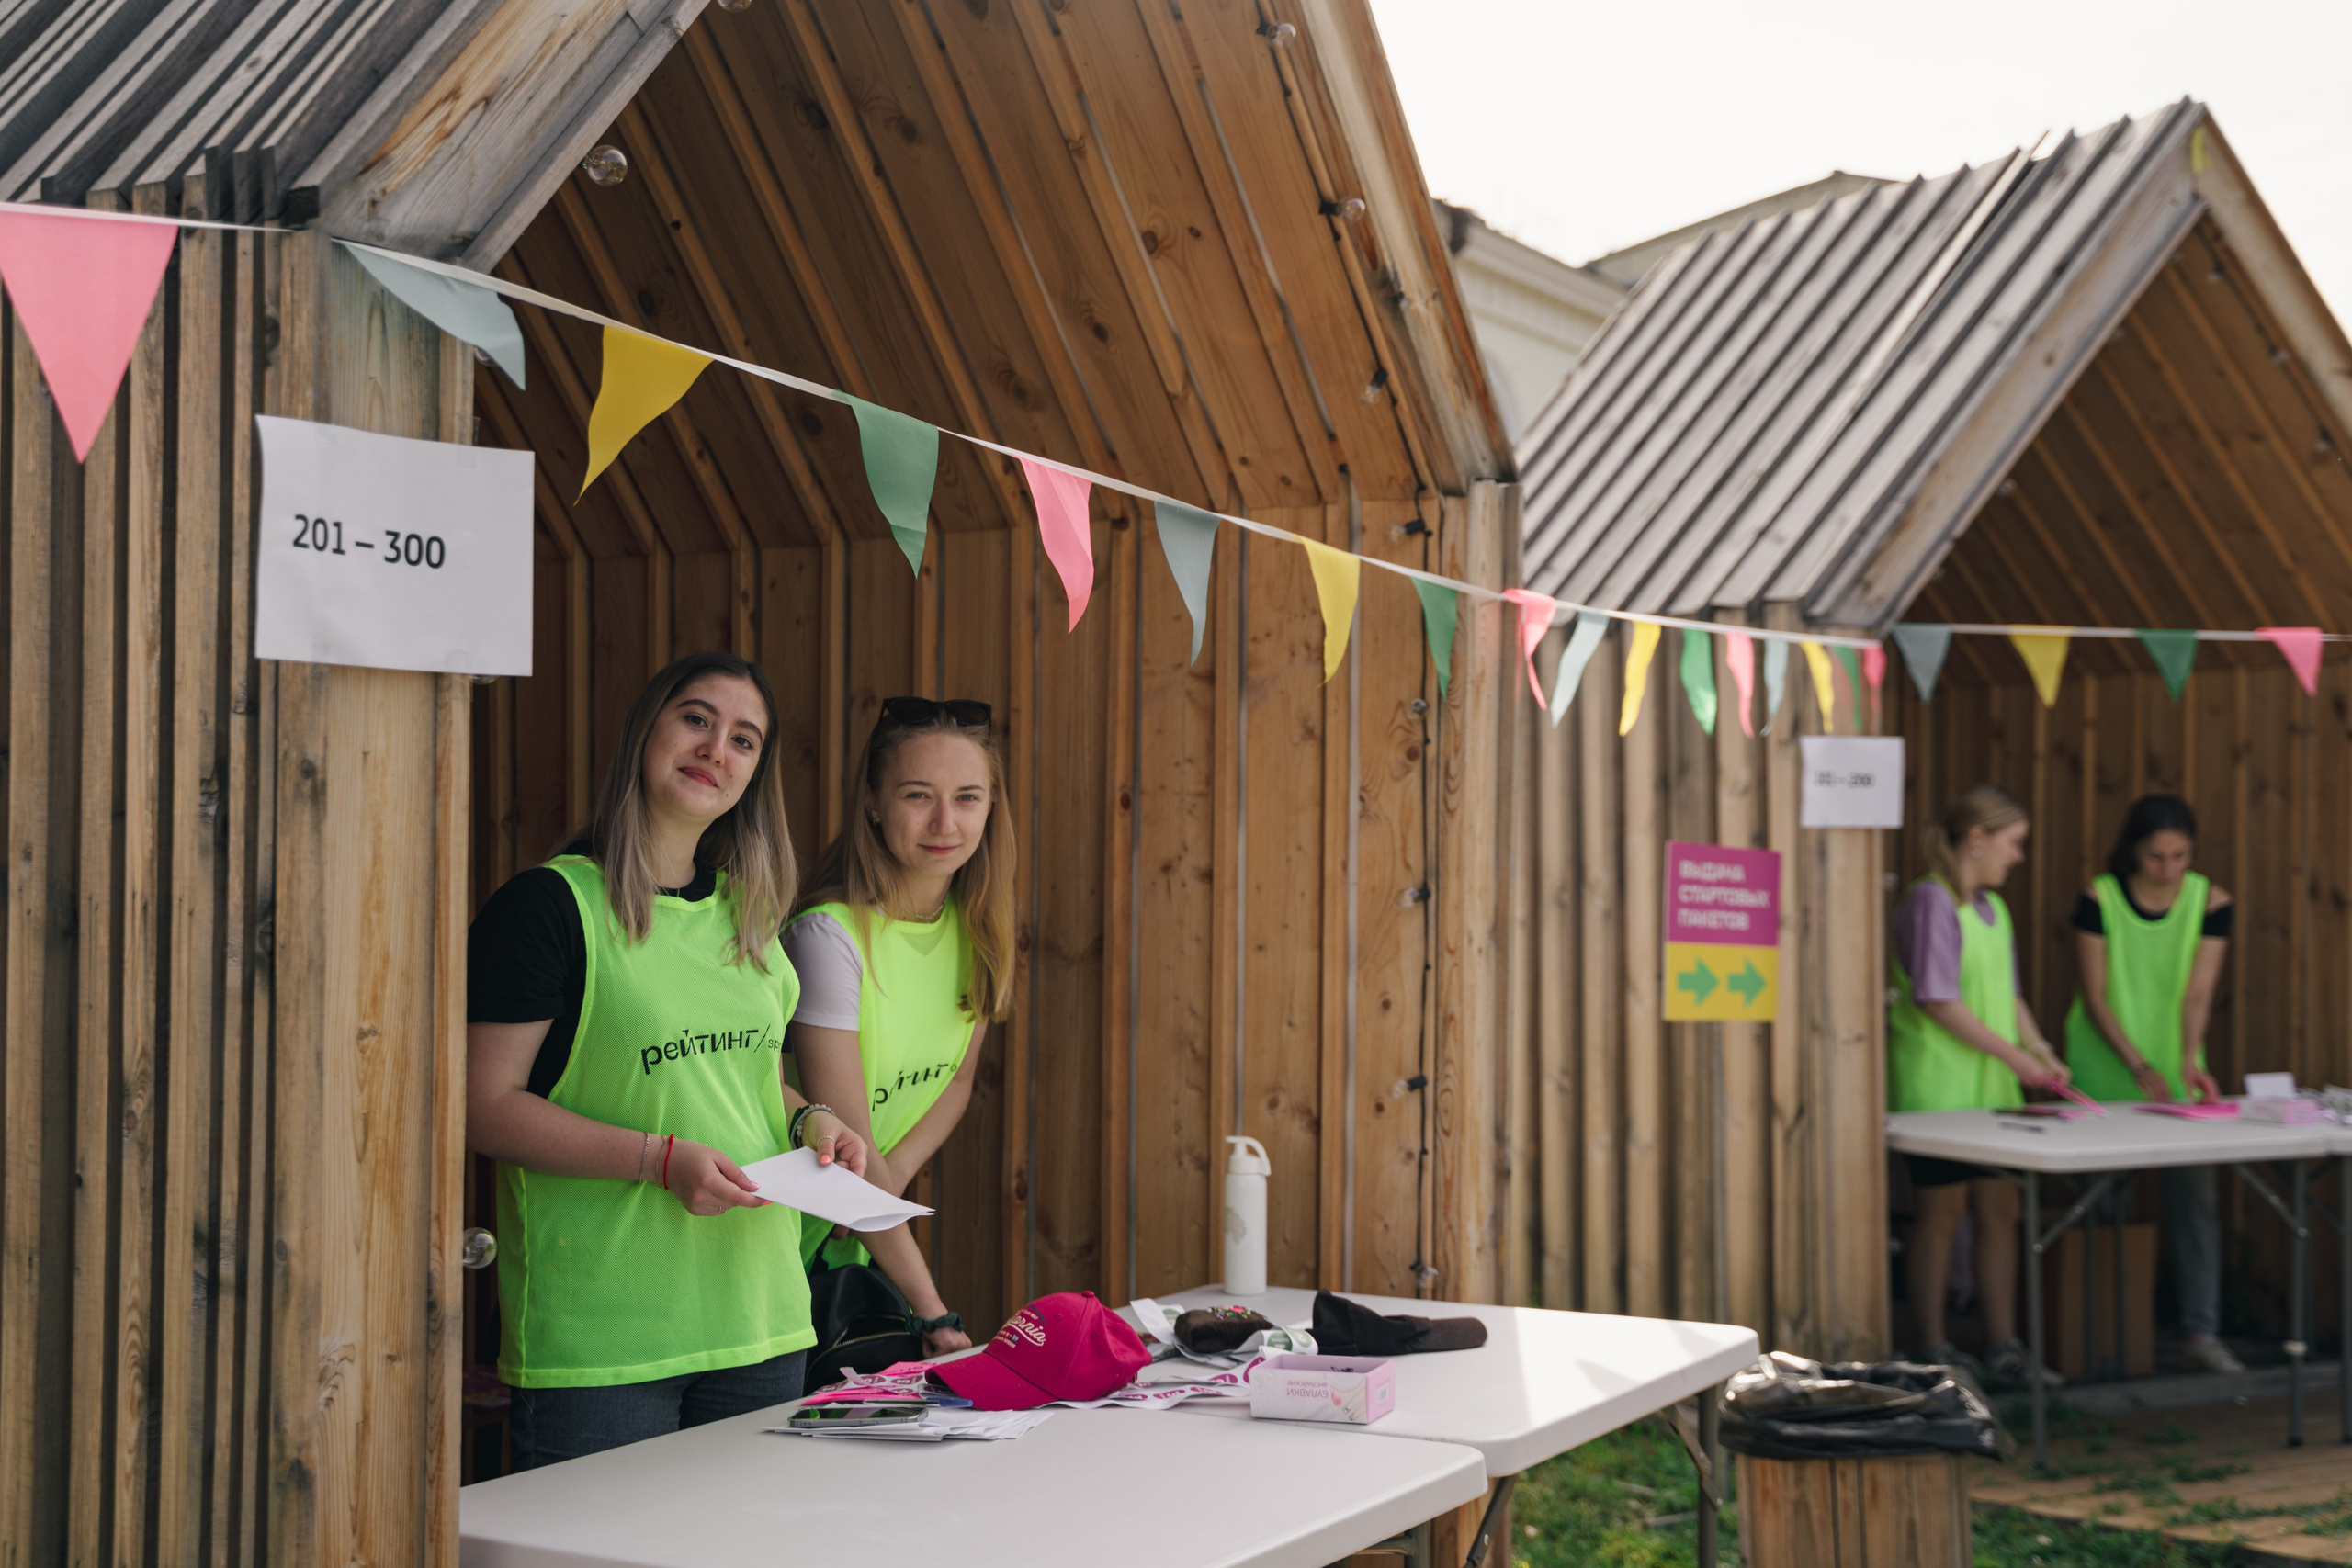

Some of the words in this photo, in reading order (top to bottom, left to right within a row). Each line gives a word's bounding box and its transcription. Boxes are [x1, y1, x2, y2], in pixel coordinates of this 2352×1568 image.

[1679, 859, 1747, 885] ВЫДАЧА
[1678, 884, 1771, 908] СТАРТОВЫХ
[1677, 908, 1749, 931] ПАКЕТОВ
[1286, 1388, 1329, 1399] БУЛАВКИ
